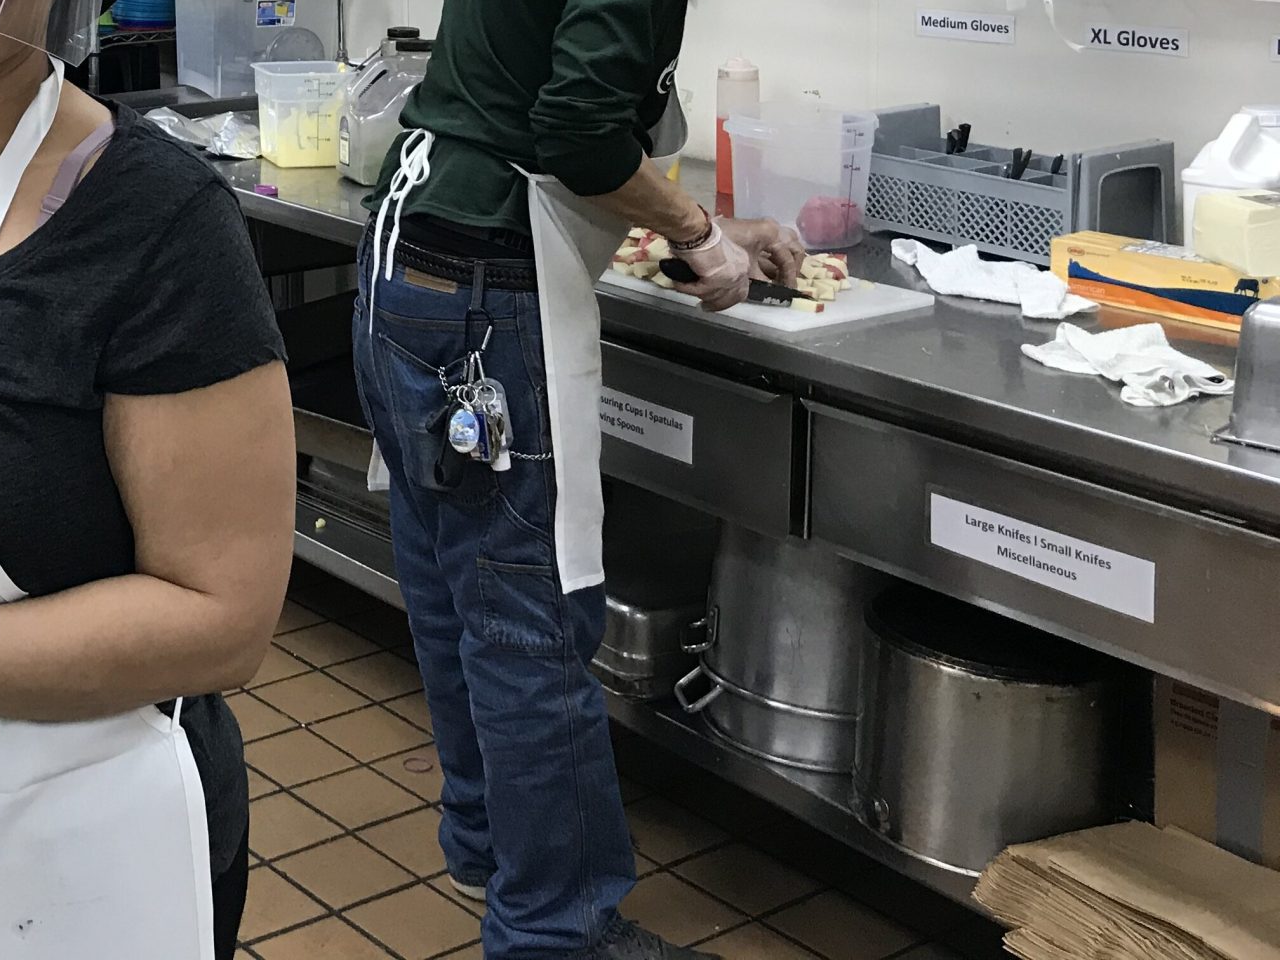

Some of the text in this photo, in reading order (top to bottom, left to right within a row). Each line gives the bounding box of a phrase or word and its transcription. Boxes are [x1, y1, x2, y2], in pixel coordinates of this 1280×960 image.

[921, 16, 1009, 34] Medium Gloves
[1091, 28, 1180, 51] XL Gloves
[600, 412, 644, 435] ving Spoons
[601, 395, 624, 411] suring
[625, 403, 643, 417] Cups
[649, 411, 683, 430] Spatulas
[965, 514, 995, 532] Large
[997, 524, 1031, 544] Knifes
[1040, 538, 1071, 558] Small
[1075, 549, 1112, 570] Knifes
[997, 545, 1077, 581] Miscellaneous
